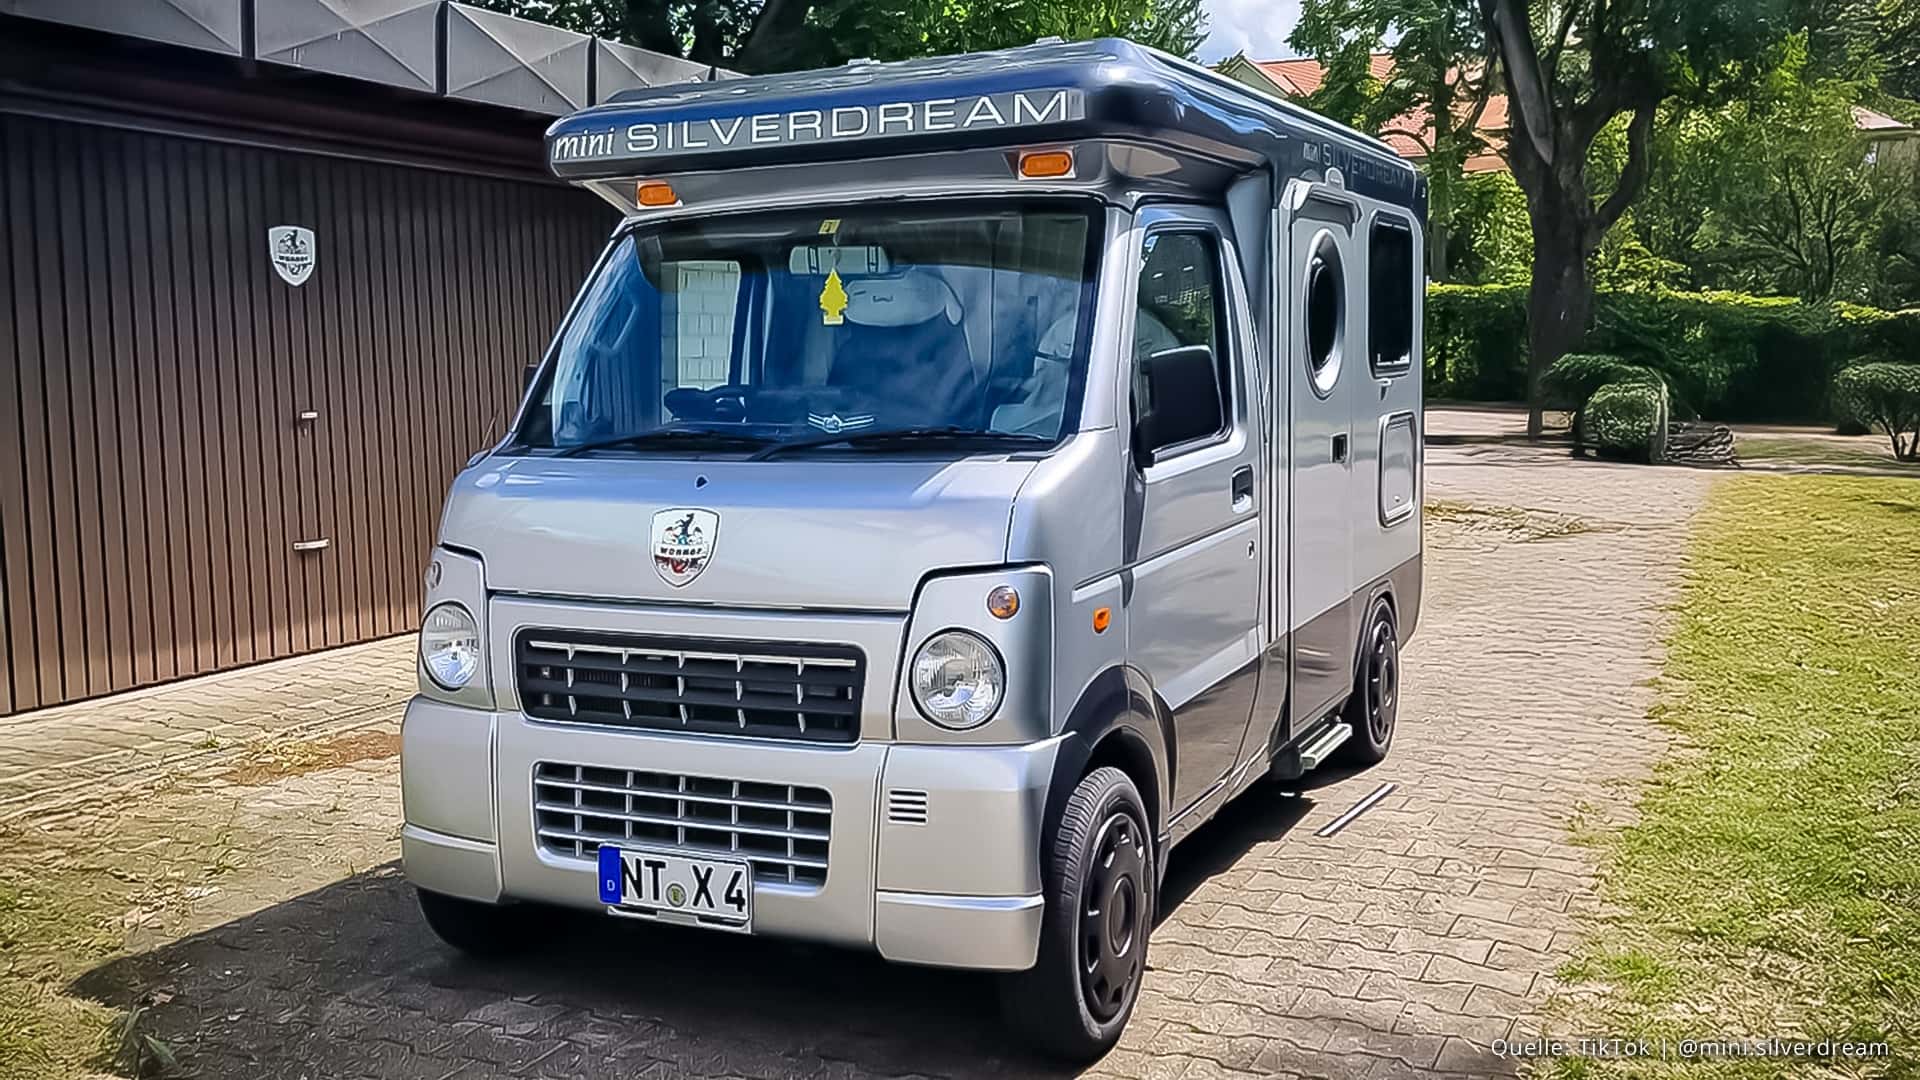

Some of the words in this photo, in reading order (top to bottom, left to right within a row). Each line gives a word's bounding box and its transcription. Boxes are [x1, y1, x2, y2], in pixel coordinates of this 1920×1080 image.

[554, 127, 615, 159] mini
[627, 90, 1070, 152] SILVERDREAM
[621, 856, 667, 901] NT
[692, 864, 715, 909] X
[724, 870, 746, 912] 4
